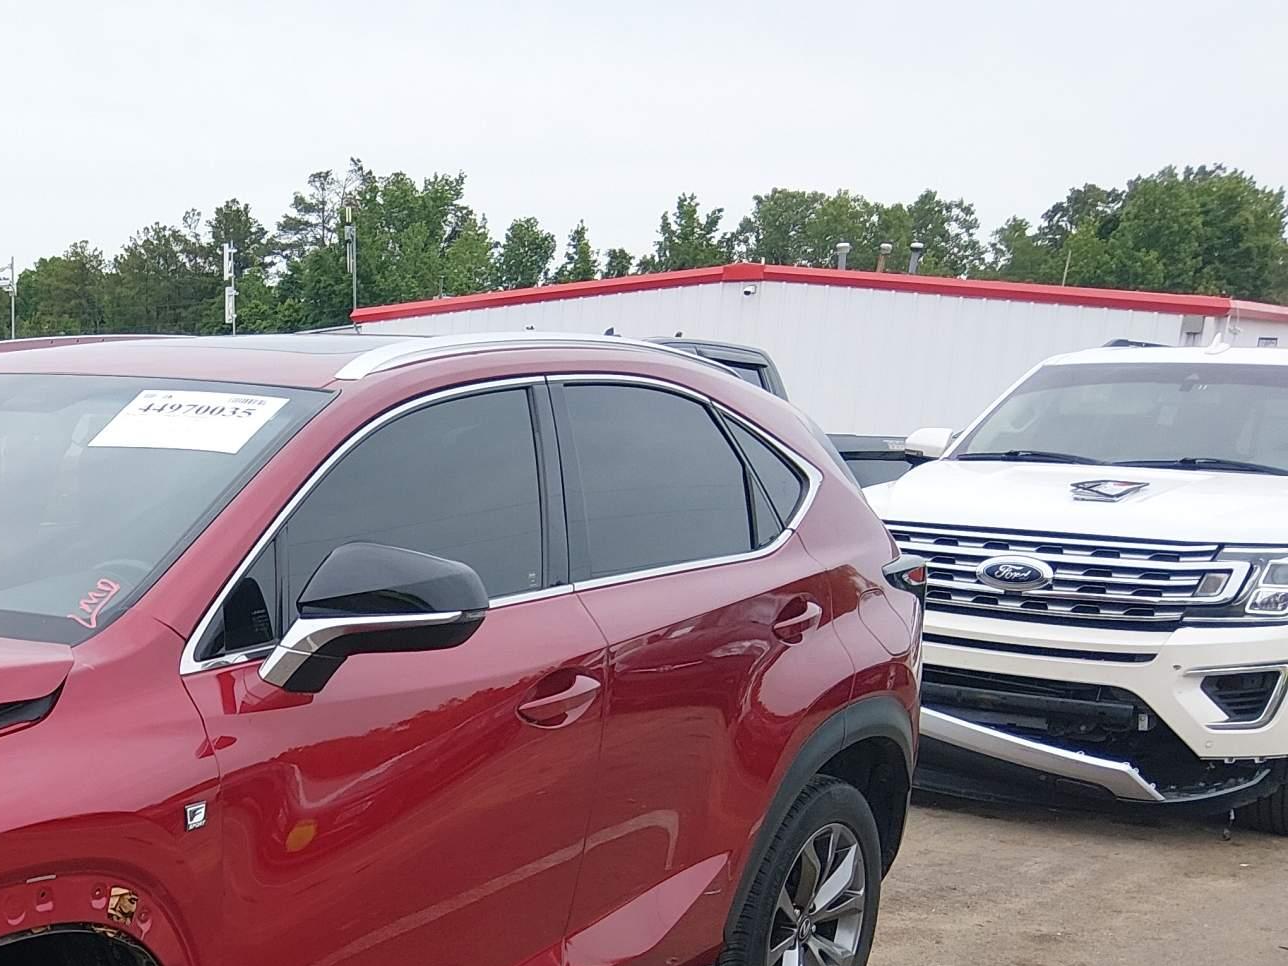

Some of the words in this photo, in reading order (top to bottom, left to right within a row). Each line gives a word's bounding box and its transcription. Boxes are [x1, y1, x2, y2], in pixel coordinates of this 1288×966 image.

[138, 402, 257, 418] 44970035
[995, 564, 1031, 581] Ford
[188, 819, 207, 831] SPORT
